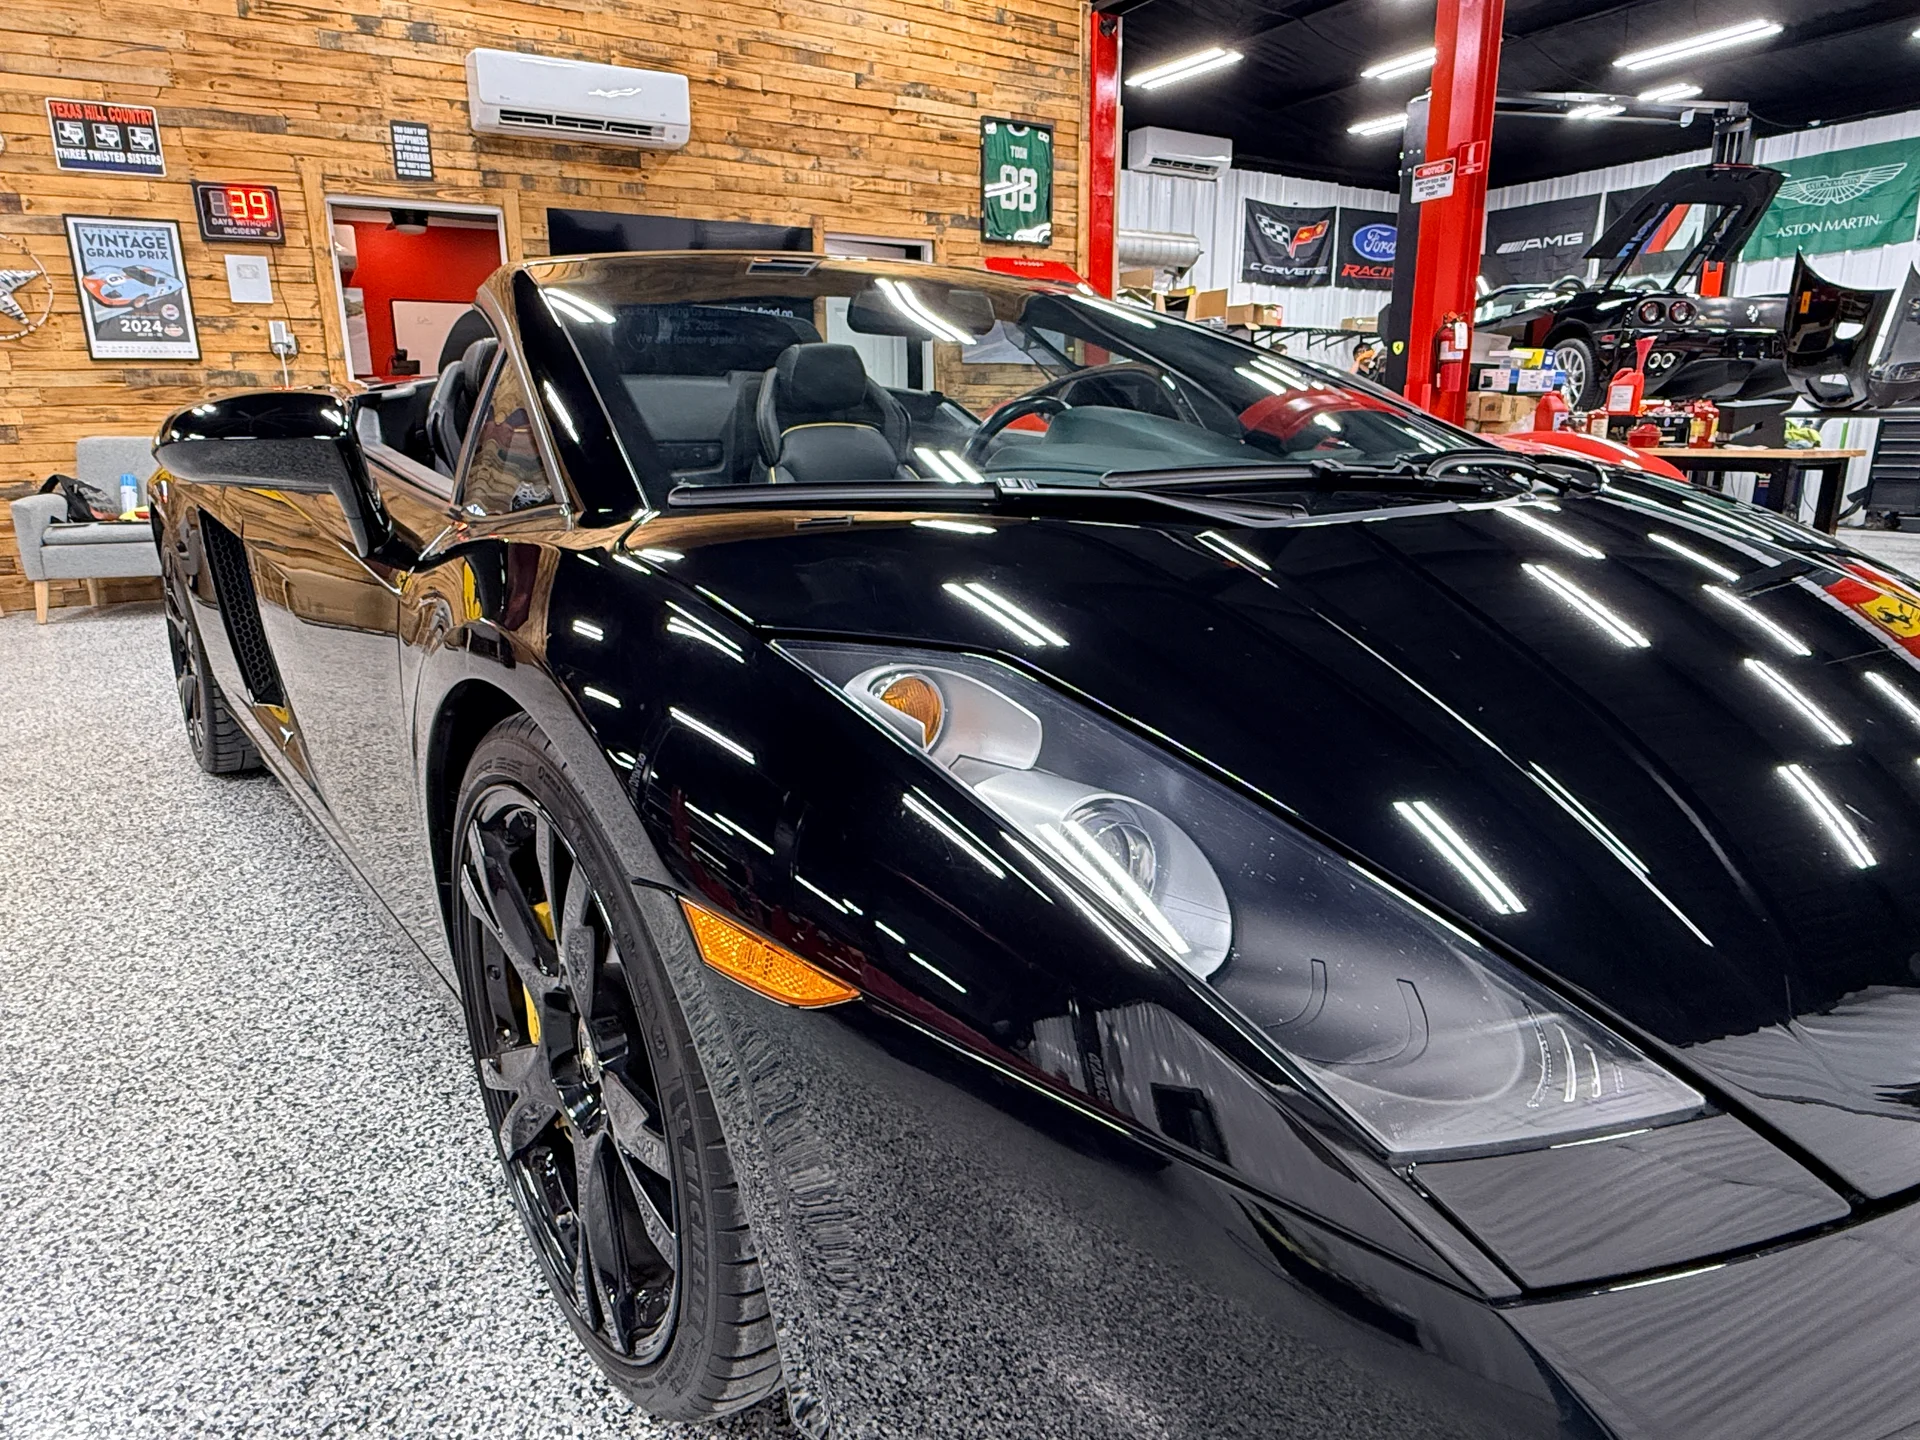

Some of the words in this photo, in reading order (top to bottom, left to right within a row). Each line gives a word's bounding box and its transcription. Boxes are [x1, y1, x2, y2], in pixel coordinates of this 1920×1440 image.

[49, 101, 83, 119] TEXAS
[84, 104, 107, 121] HILL
[108, 107, 153, 125] COUNTRY
[394, 134, 428, 146] HAPPINESS
[57, 148, 87, 160] THREE
[87, 150, 125, 163] TWISTED
[127, 152, 162, 165] SISTERS
[1423, 165, 1445, 176] NOTICE
[1000, 164, 1038, 212] 88
[1415, 178, 1439, 187] EMPLOYEES
[1419, 185, 1435, 193] BEYOND
[1805, 181, 1832, 191] ASTON
[1832, 176, 1860, 187] MARTIN
[228, 190, 268, 219] 39
[211, 218, 233, 226] DAYS
[235, 219, 272, 228] WITHOUT
[1776, 222, 1823, 239] ASTON
[1824, 214, 1880, 232] MARTIN
[223, 227, 261, 235] INCIDENT
[83, 233, 168, 250] VINTAGE
[1364, 229, 1397, 255] Ford
[1521, 232, 1584, 251] AMG
[86, 248, 134, 259] GRAND
[138, 250, 169, 260] PRIX
[1250, 262, 1329, 276] CORVETTE
[1341, 263, 1394, 278] RACIN
[120, 319, 163, 333] 2024
[682, 1145, 706, 1328] MICHELIN
